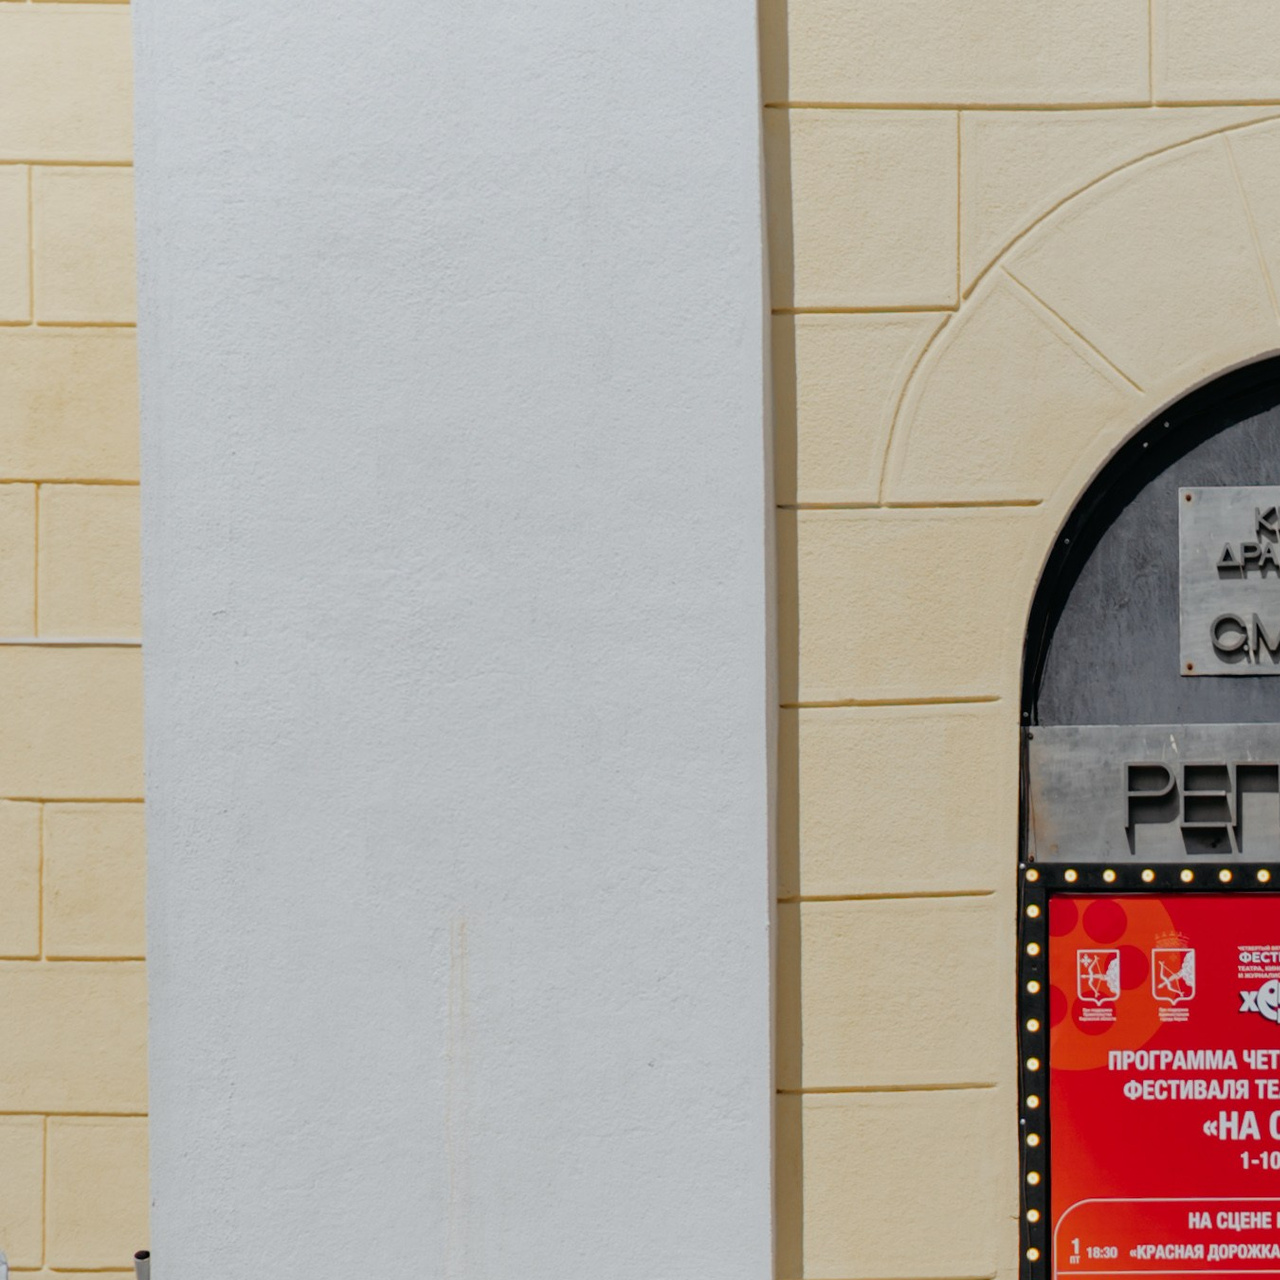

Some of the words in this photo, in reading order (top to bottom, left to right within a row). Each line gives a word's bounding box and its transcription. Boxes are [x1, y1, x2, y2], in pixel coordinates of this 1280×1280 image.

[1108, 1049, 1238, 1071] ПРОГРАММА
[1123, 1079, 1249, 1100] ФЕСТИВАЛЯ
[1203, 1110, 1261, 1140] «НА
[1188, 1212, 1212, 1229] НА
[1216, 1211, 1272, 1232] СЦЕНЕ
[1071, 1238, 1079, 1254] 1
[1086, 1246, 1118, 1259] 18:30
[1130, 1244, 1204, 1259] «КРАСНАЯ
